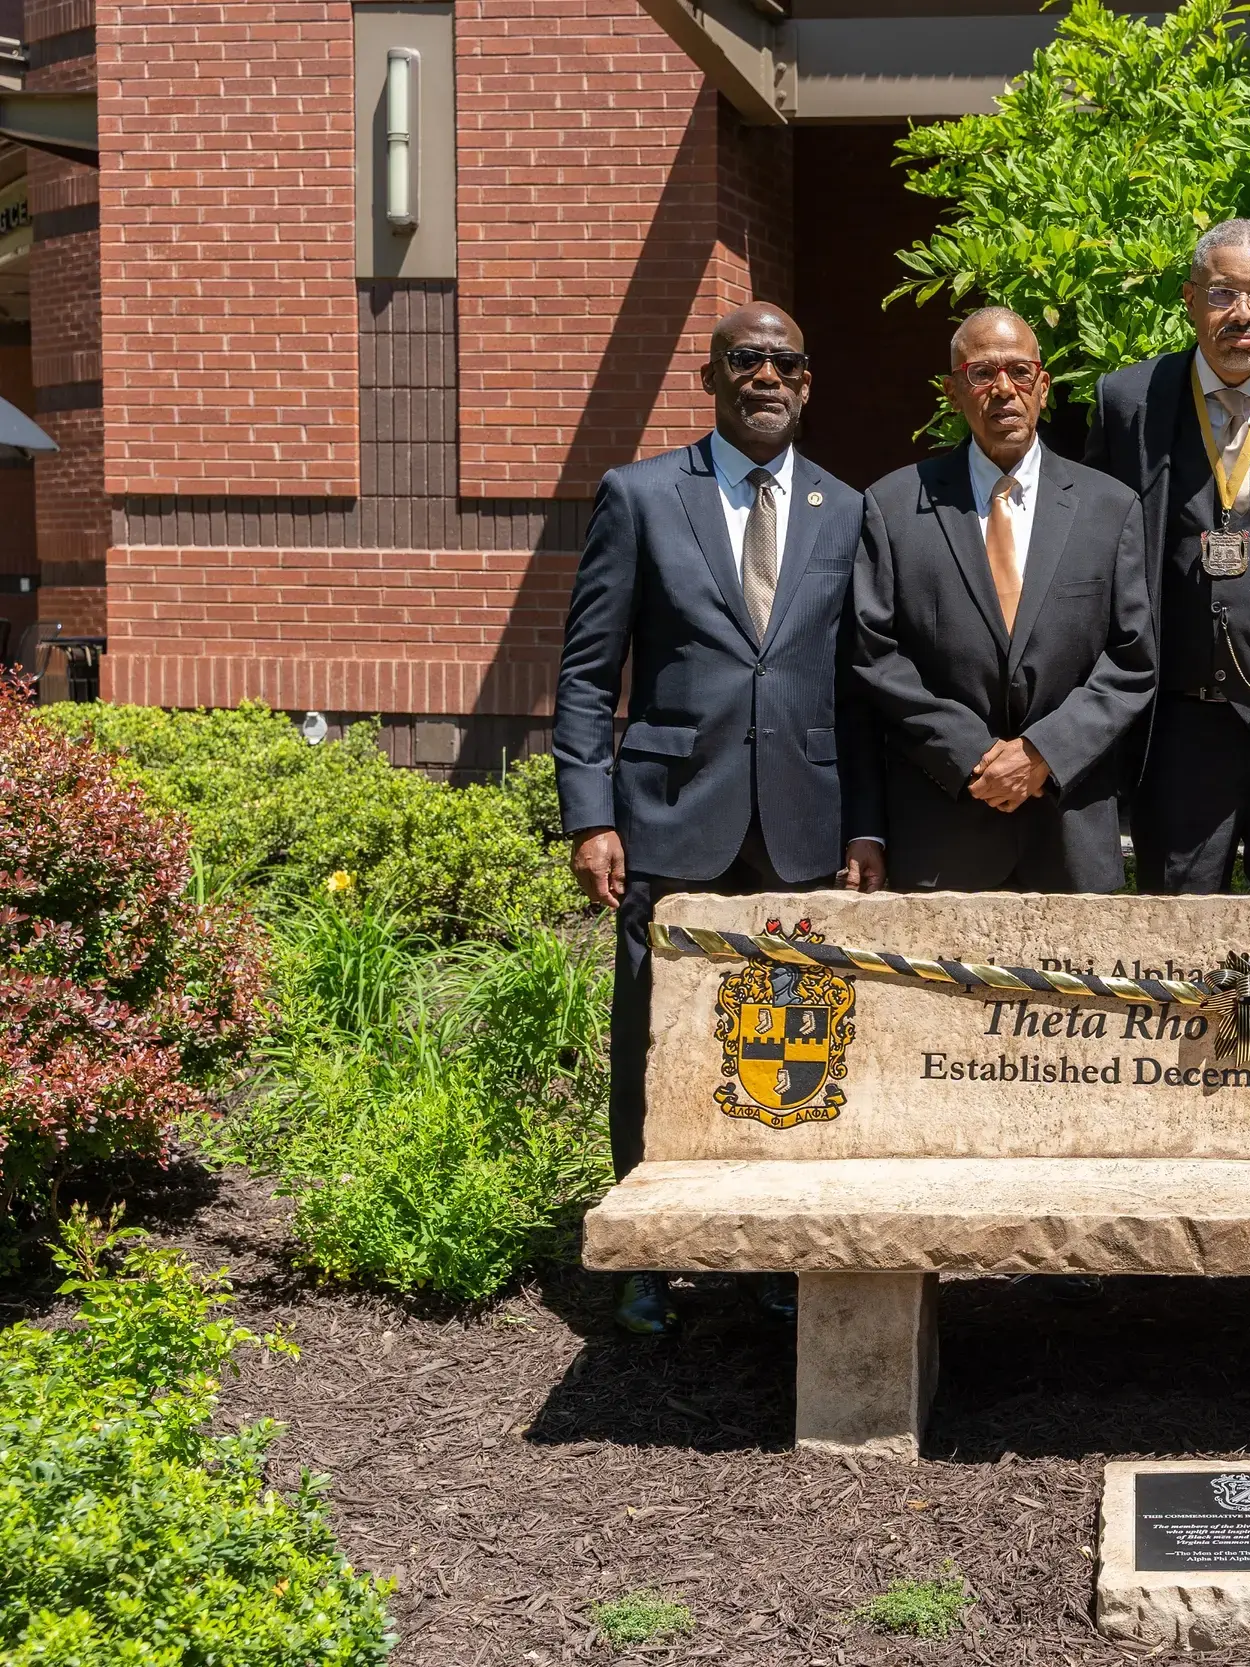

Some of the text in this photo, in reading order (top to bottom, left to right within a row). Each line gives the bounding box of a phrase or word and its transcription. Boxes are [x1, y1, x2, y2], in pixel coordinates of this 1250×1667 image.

[983, 998, 1107, 1039] Theta
[1120, 1002, 1209, 1041] Rho
[920, 1052, 1122, 1085] Established
